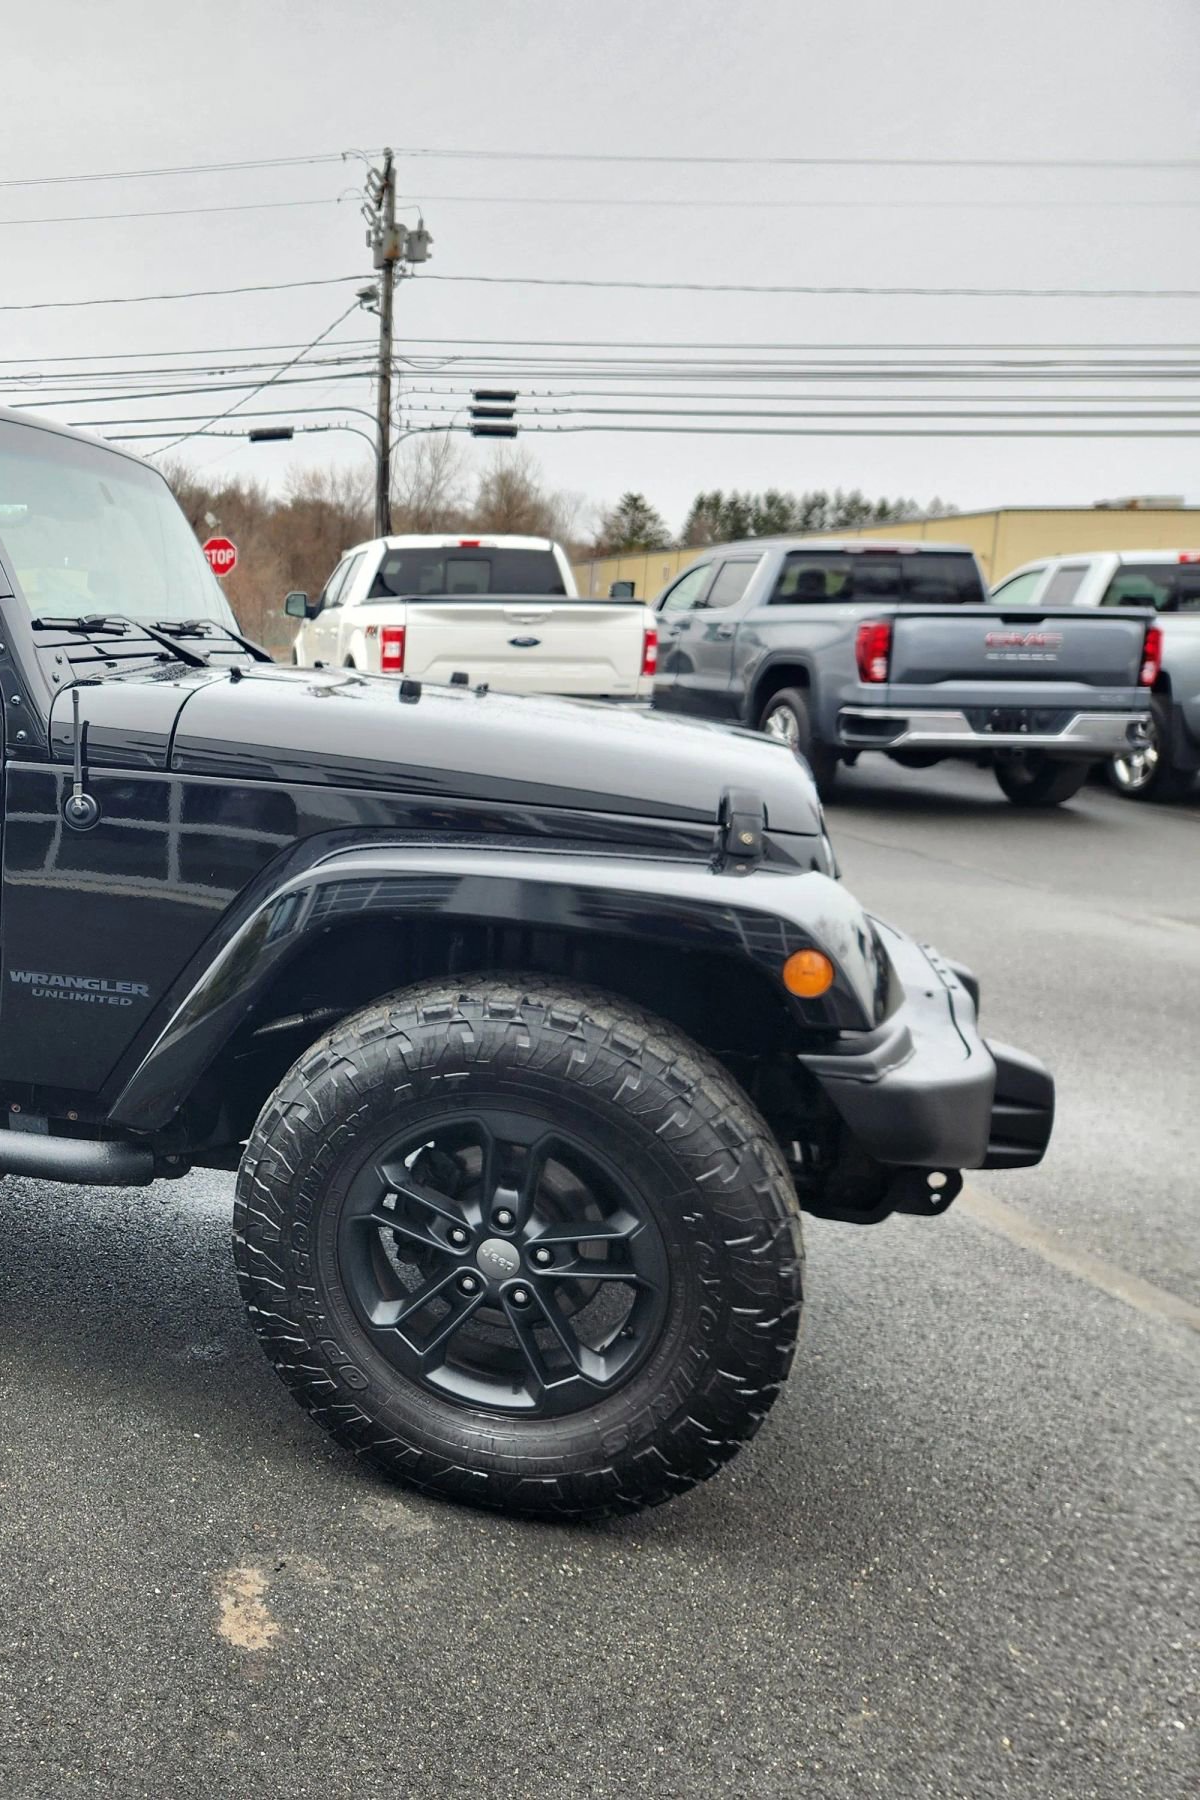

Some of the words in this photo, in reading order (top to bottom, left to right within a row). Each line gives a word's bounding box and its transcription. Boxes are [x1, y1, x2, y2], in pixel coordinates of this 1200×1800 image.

[204, 548, 235, 565] STOP
[9, 970, 150, 998] WRANGLER
[31, 988, 133, 1006] UNLIMITED
[297, 1284, 370, 1391] OPEN
